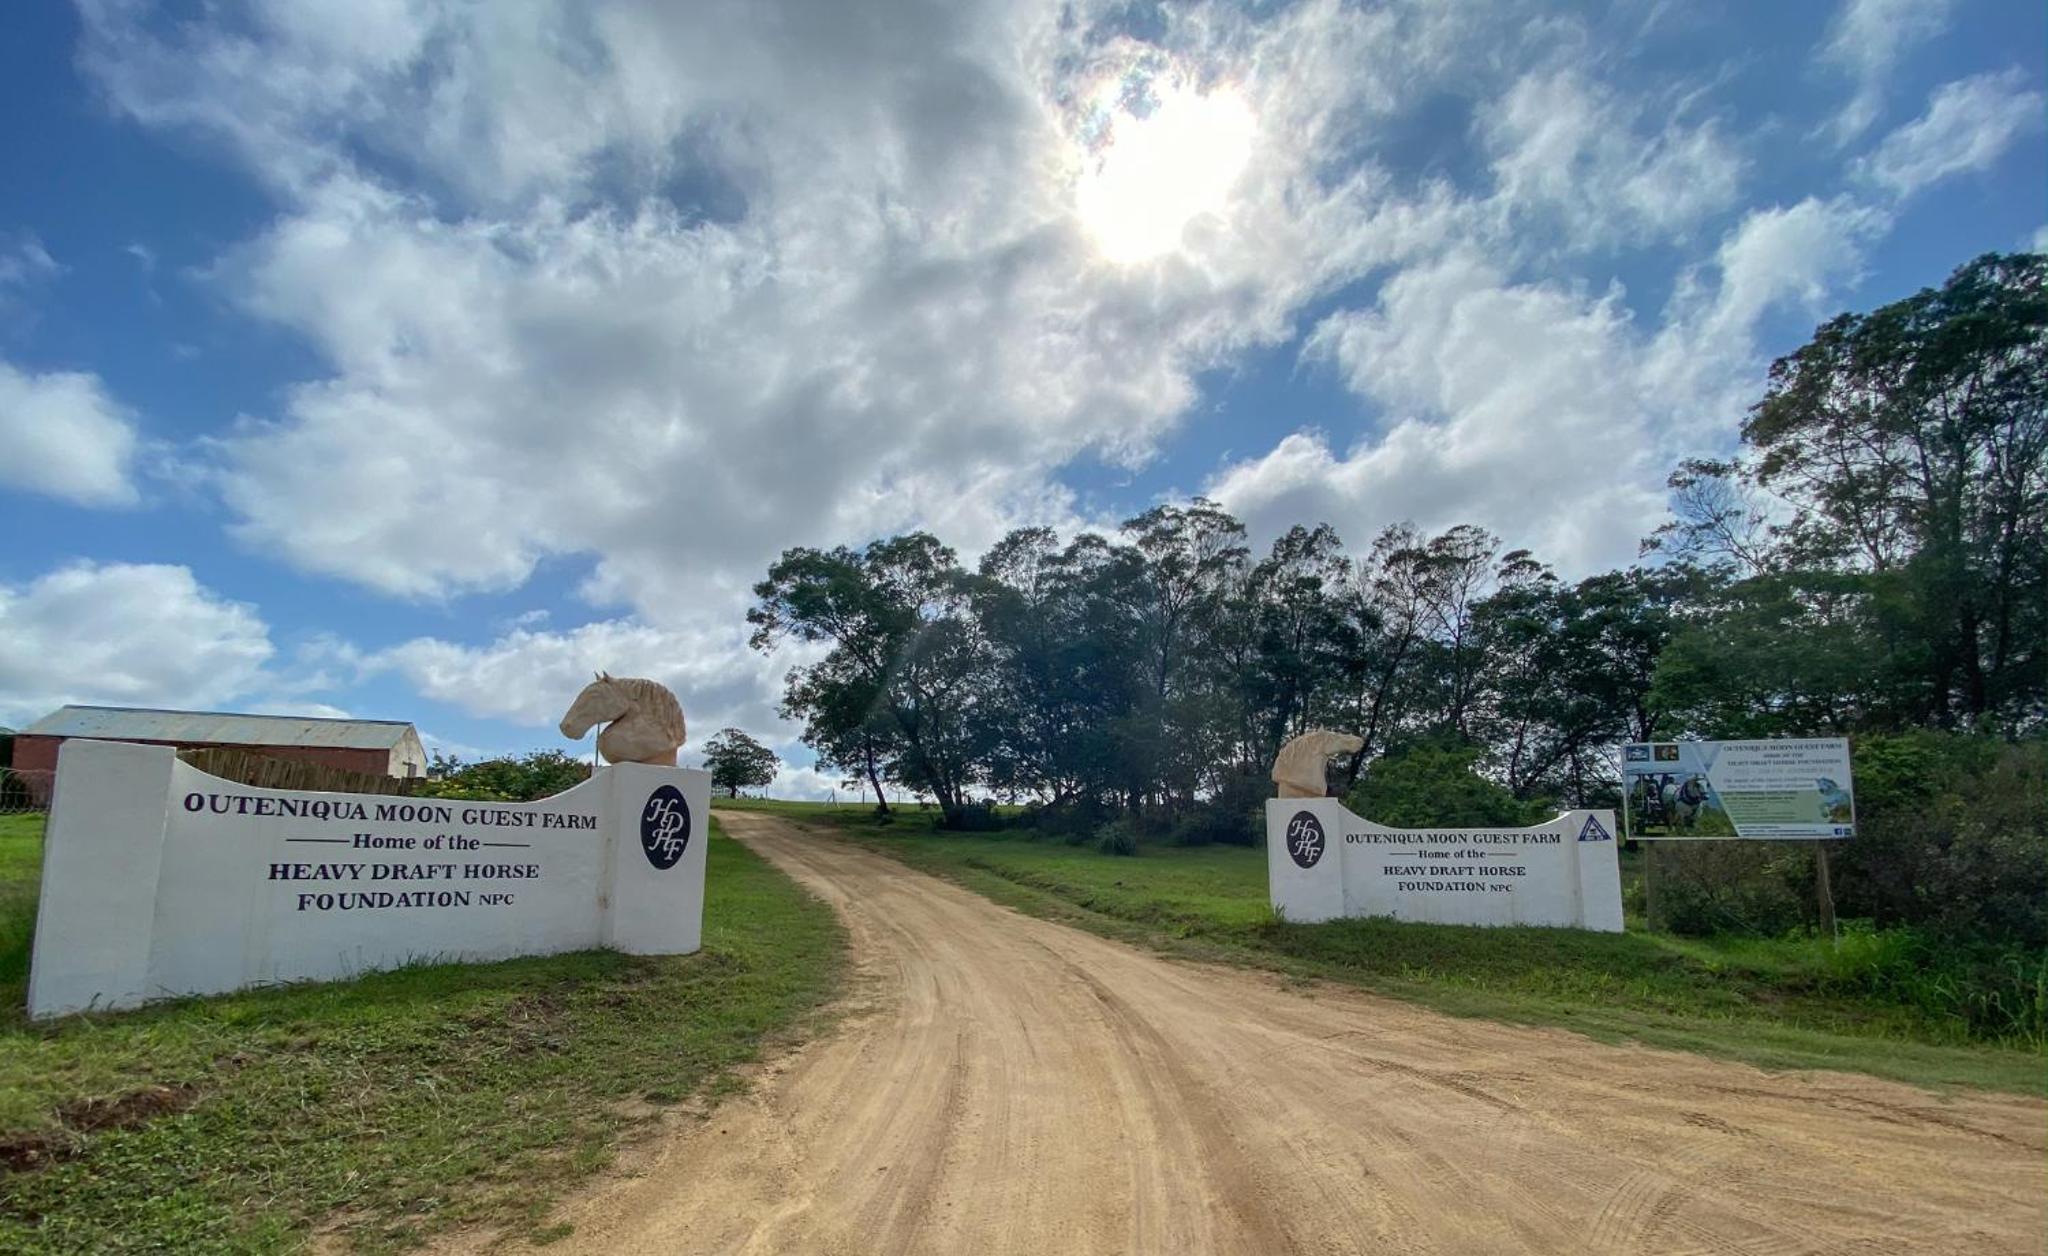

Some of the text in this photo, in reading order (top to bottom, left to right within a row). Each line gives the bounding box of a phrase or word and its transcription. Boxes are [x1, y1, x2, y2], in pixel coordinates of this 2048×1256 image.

[184, 793, 598, 831] OUTENIQUA MOON GUEST FARM
[353, 833, 481, 851] Home of the
[1345, 833, 1561, 845] OUTENIQUA MOON GUEST FARM
[1418, 849, 1487, 859] Home of the
[267, 863, 539, 881] HEAVY DRAFT HORSE
[1383, 865, 1526, 877] HEAVY DRAFT HORSE
[1398, 881, 1513, 893] FOUNDATION NPC
[297, 890, 515, 912] FOUNDATION NPC
